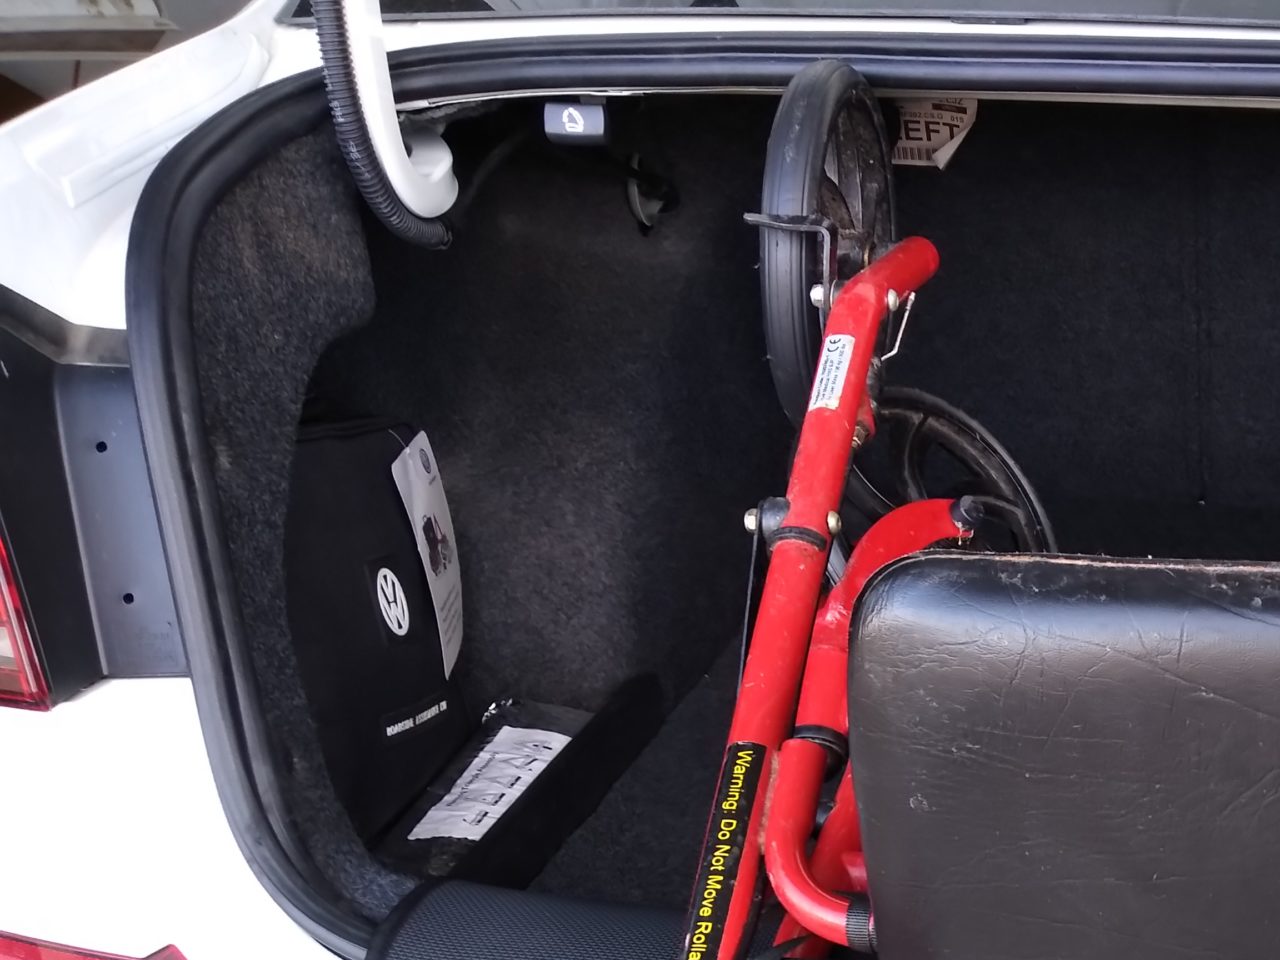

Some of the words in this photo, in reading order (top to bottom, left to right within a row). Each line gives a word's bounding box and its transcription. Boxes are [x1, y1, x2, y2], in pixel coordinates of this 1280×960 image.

[899, 119, 961, 142] EFT
[721, 750, 753, 814] Warning:
[717, 818, 738, 841] Do
[711, 844, 732, 872] Not
[698, 874, 724, 918] Move
